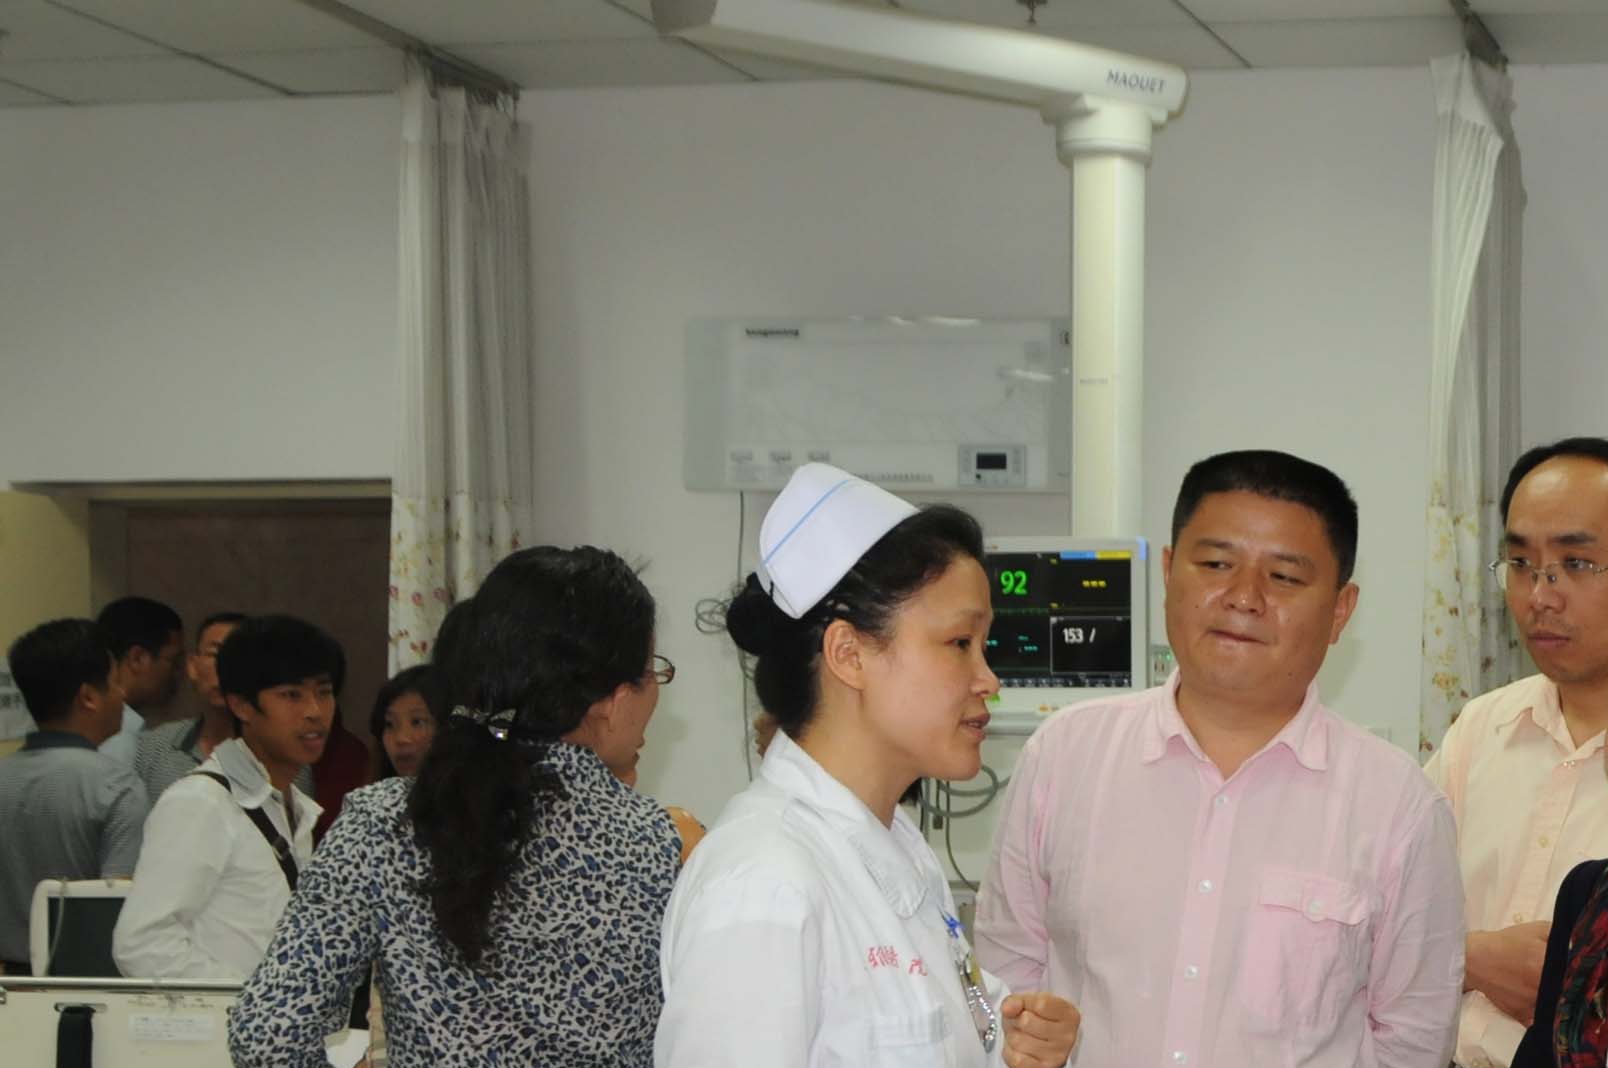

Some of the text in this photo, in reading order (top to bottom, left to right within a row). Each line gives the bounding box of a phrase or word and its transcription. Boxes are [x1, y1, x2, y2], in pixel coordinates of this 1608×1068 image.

[1106, 69, 1165, 93] MAQUET
[1000, 570, 1027, 595] 92
[1063, 628, 1084, 643] 153
